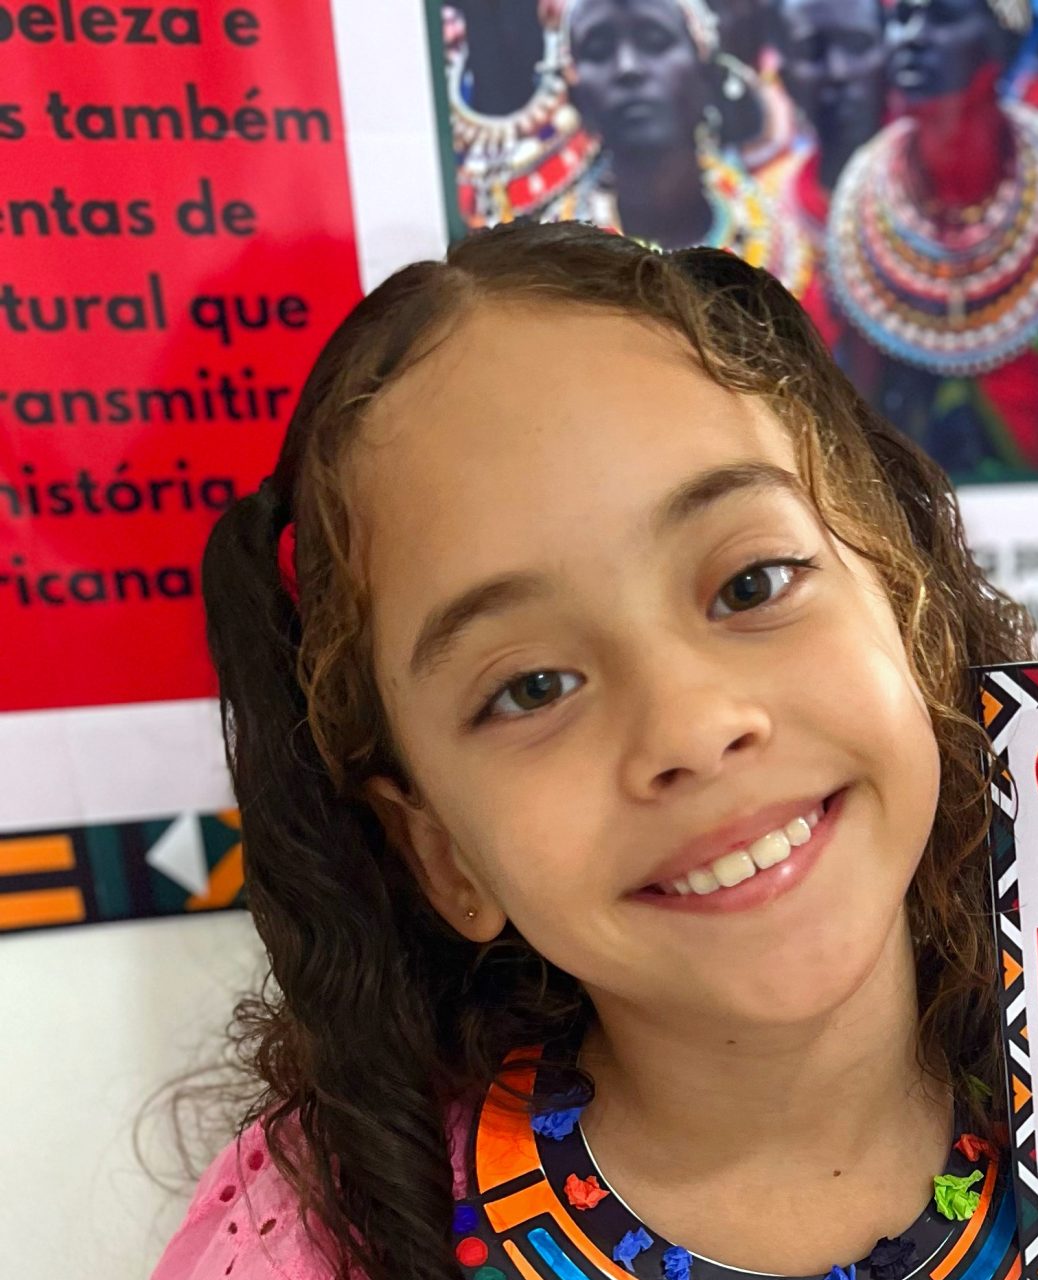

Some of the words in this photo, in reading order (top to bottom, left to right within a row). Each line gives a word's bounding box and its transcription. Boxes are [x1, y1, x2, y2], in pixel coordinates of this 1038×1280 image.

[0, 0, 201, 44] eleza
[224, 8, 260, 45] e
[47, 83, 332, 143] também
[0, 187, 155, 236] ntas
[177, 178, 257, 236] de
[190, 293, 310, 347] que
[0, 368, 291, 425] ansmitir
[0, 554, 194, 606] icana
